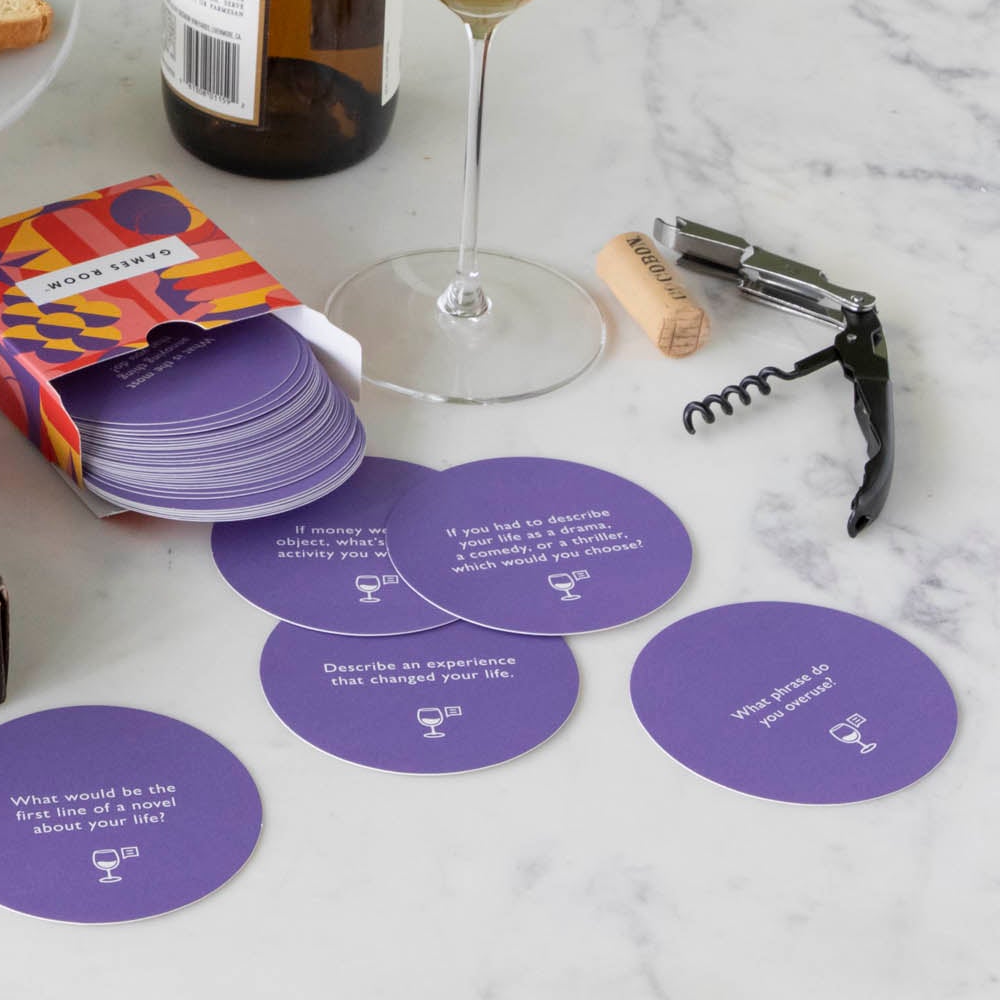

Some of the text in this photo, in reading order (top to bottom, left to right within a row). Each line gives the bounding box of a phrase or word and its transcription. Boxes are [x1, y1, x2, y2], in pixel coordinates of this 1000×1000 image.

[209, 3, 245, 18] PARMESAN
[110, 249, 171, 271] GAMES
[153, 360, 175, 372] the
[126, 371, 155, 389] most
[295, 525, 305, 534] If
[311, 527, 362, 537] money
[446, 509, 611, 538] If you had to describe
[276, 537, 385, 548] object, what's
[456, 553, 465, 561] a
[470, 544, 532, 559] comedy,
[536, 541, 554, 550] or
[559, 539, 568, 548] a
[459, 537, 494, 550] your
[497, 532, 522, 543] life
[526, 530, 543, 539] as
[548, 529, 556, 537] a
[278, 549, 334, 560] activity
[340, 551, 368, 560] you
[451, 539, 644, 574] which would you choose?
[323, 657, 517, 673] Describe an experience
[331, 669, 515, 687] that changed your life.
[730, 663, 830, 720] What phrase do
[759, 676, 837, 729] you overuse?
[10, 783, 177, 807] What would be the
[16, 796, 177, 822] first line of a novel
[33, 811, 166, 835] about your life?
